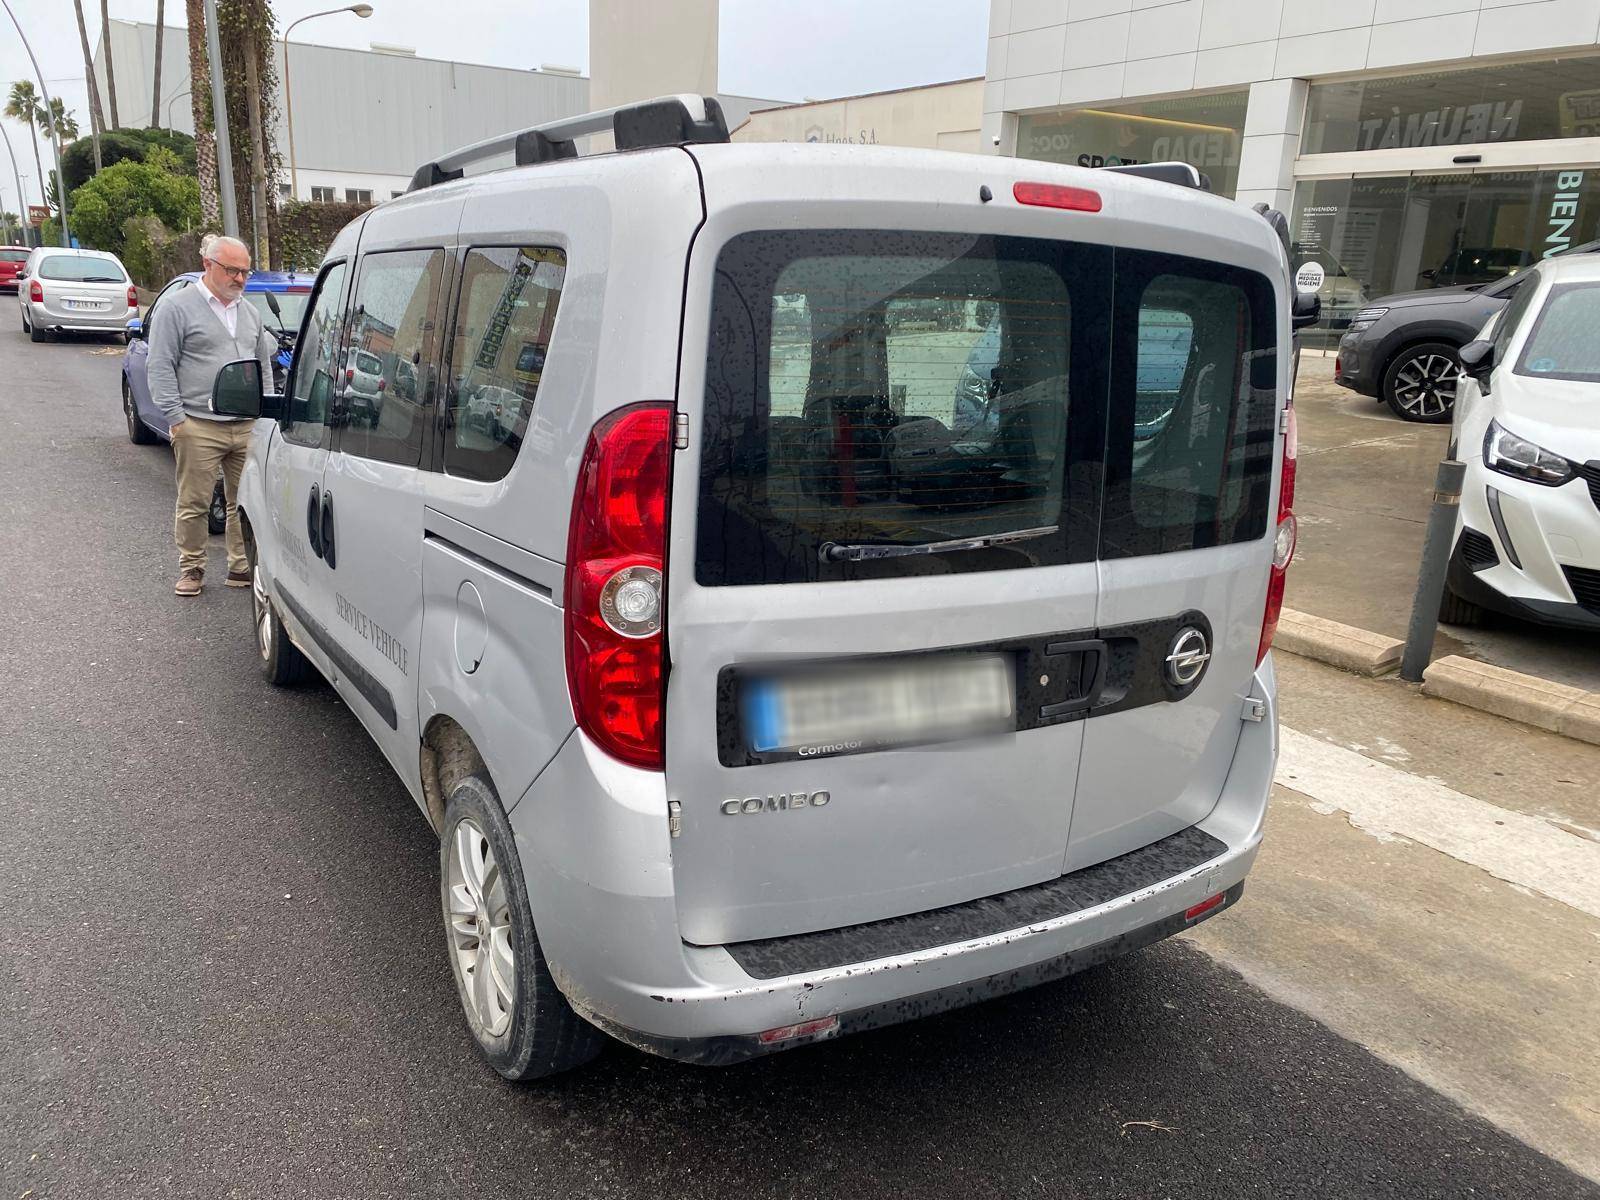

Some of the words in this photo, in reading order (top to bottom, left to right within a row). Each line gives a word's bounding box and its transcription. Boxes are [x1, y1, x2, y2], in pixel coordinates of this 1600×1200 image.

[860, 128, 880, 145] S.A.
[336, 592, 368, 639] SERVICE
[369, 620, 408, 676] VEHICLE
[798, 740, 862, 756] Cormotor
[720, 790, 831, 816] COMBO
